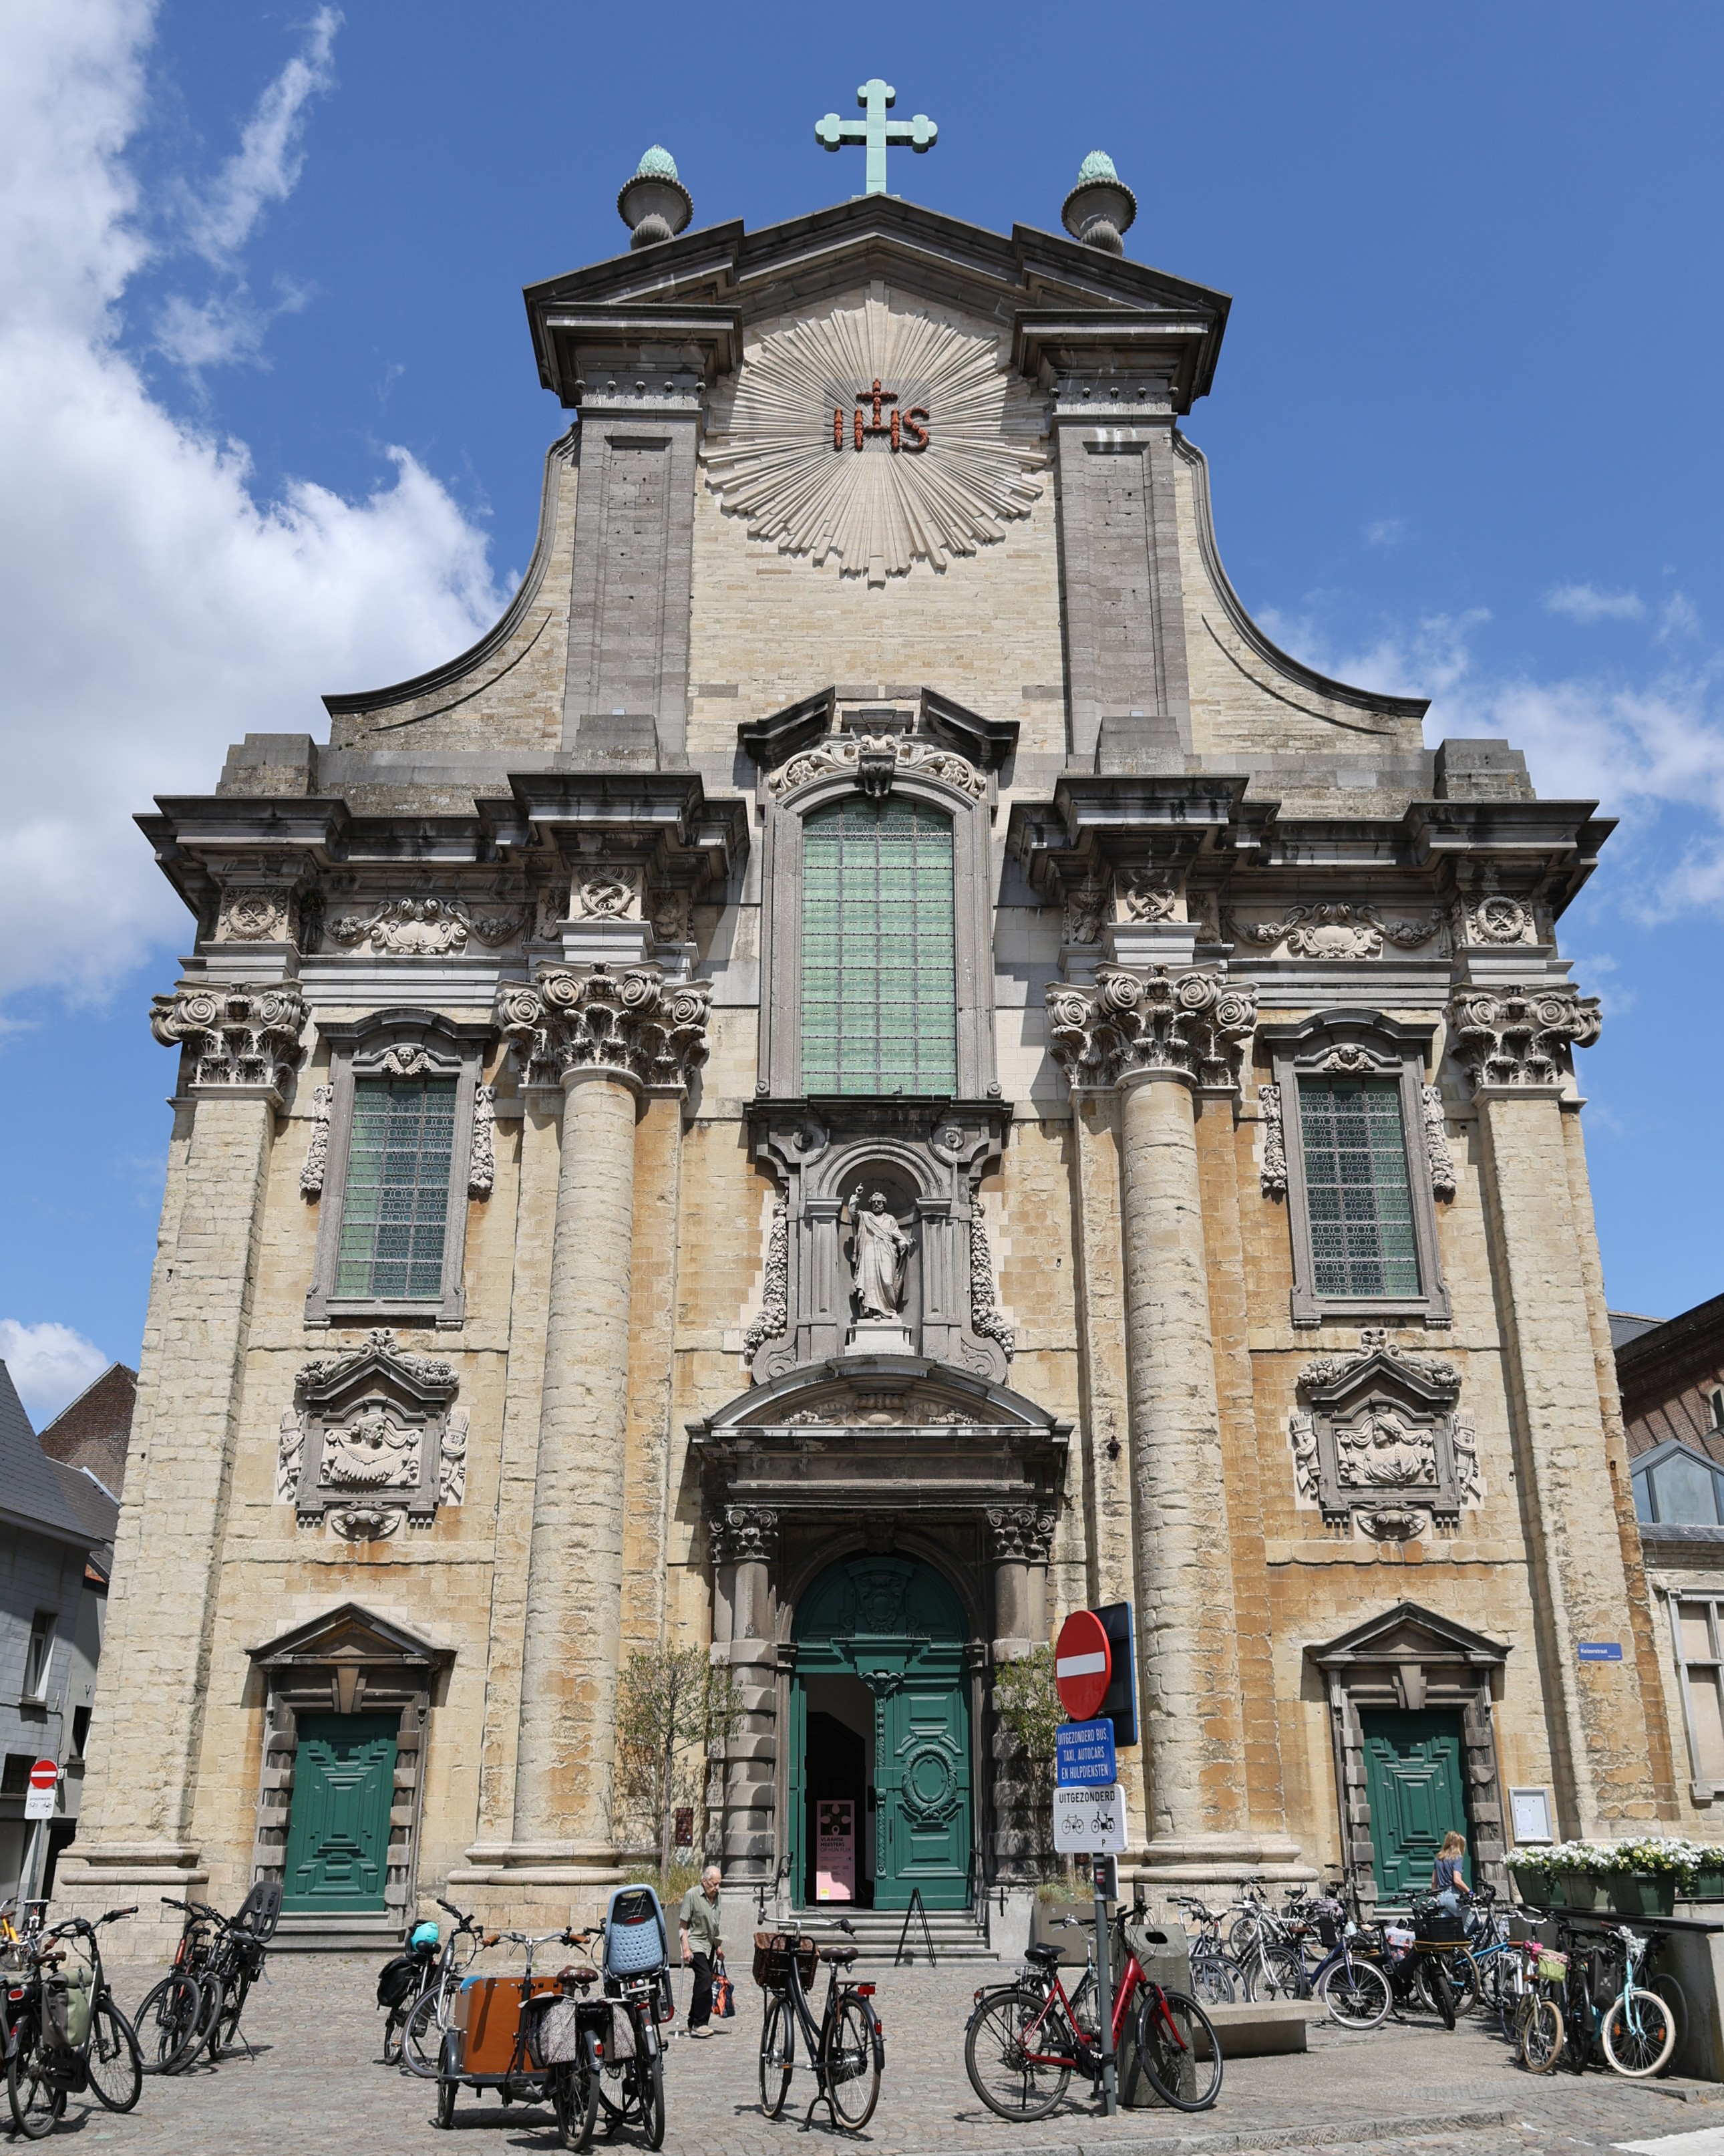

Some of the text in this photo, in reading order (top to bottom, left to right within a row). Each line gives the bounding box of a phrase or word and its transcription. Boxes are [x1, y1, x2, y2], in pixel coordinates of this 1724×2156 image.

[833, 406, 930, 452] IHS
[1057, 1727, 1109, 1745] UITGEZONDERD BUS,
[1063, 1746, 1105, 1762] TAXI, AUTOCARS
[1061, 1764, 1108, 1780] EN HULPDIENSTEN
[1059, 1791, 1115, 1804] UITGEZONDERD
[1101, 1839, 1105, 1847] P
